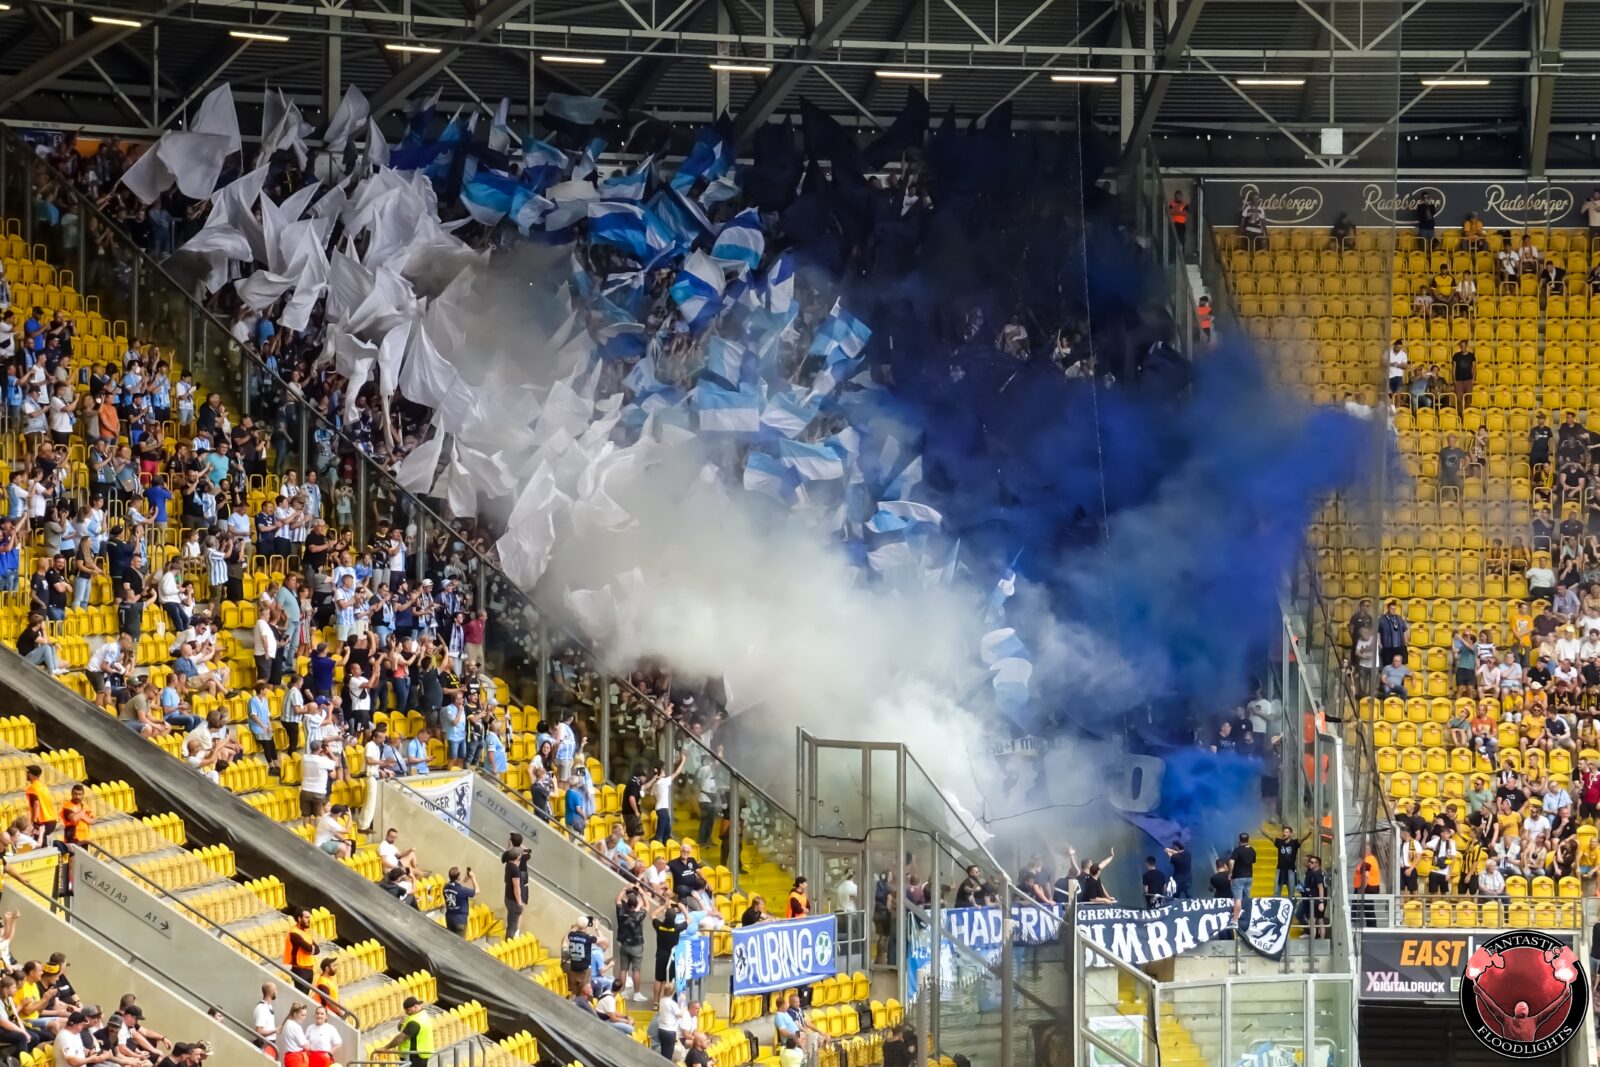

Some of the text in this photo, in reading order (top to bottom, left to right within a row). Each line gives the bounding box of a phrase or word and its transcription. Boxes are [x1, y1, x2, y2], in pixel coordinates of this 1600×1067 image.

[1484, 184, 1570, 216] Radeberger
[99, 881, 112, 893] A2
[115, 890, 128, 903] A3
[144, 911, 157, 924] A1
[747, 928, 813, 985] AUBING
[1400, 939, 1466, 967] EAST
[1373, 981, 1445, 992] DIGITALDRUCK
